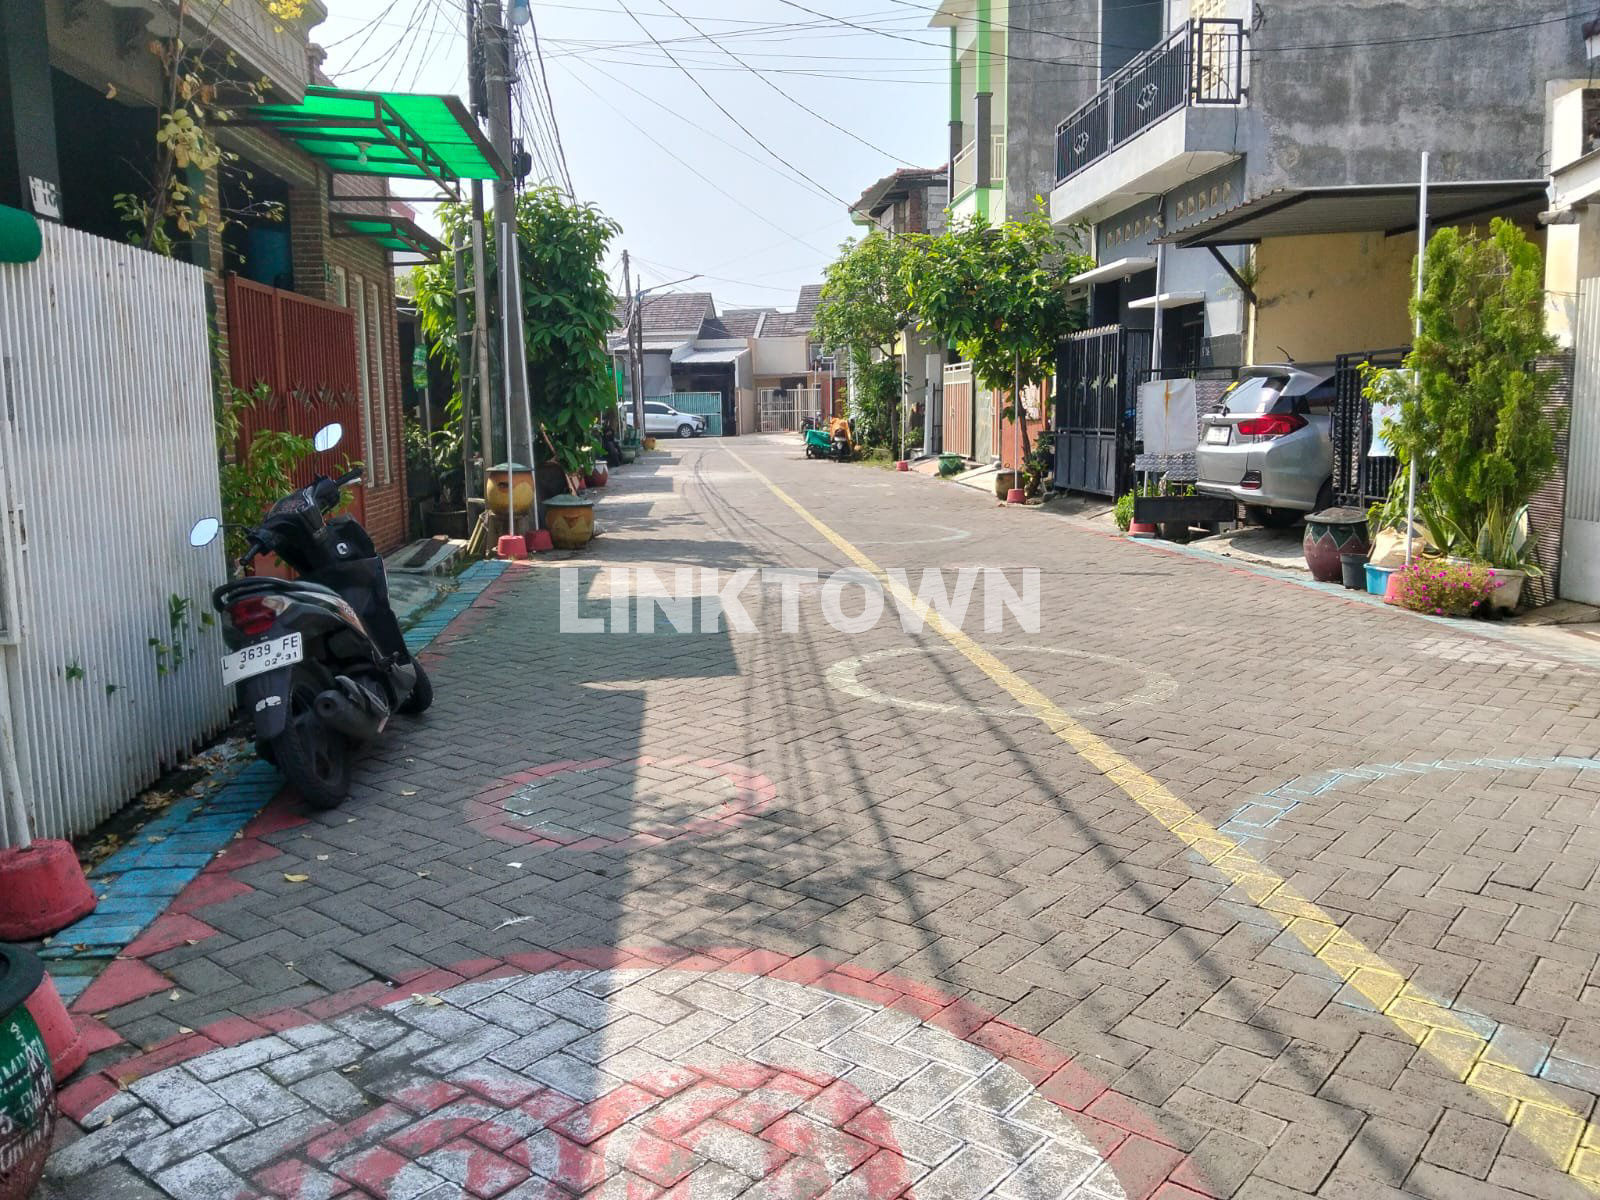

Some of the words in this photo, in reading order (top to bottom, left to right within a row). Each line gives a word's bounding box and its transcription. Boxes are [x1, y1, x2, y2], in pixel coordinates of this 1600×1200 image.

[222, 658, 229, 670] L
[240, 643, 271, 663] 3639
[282, 635, 298, 651] FE
